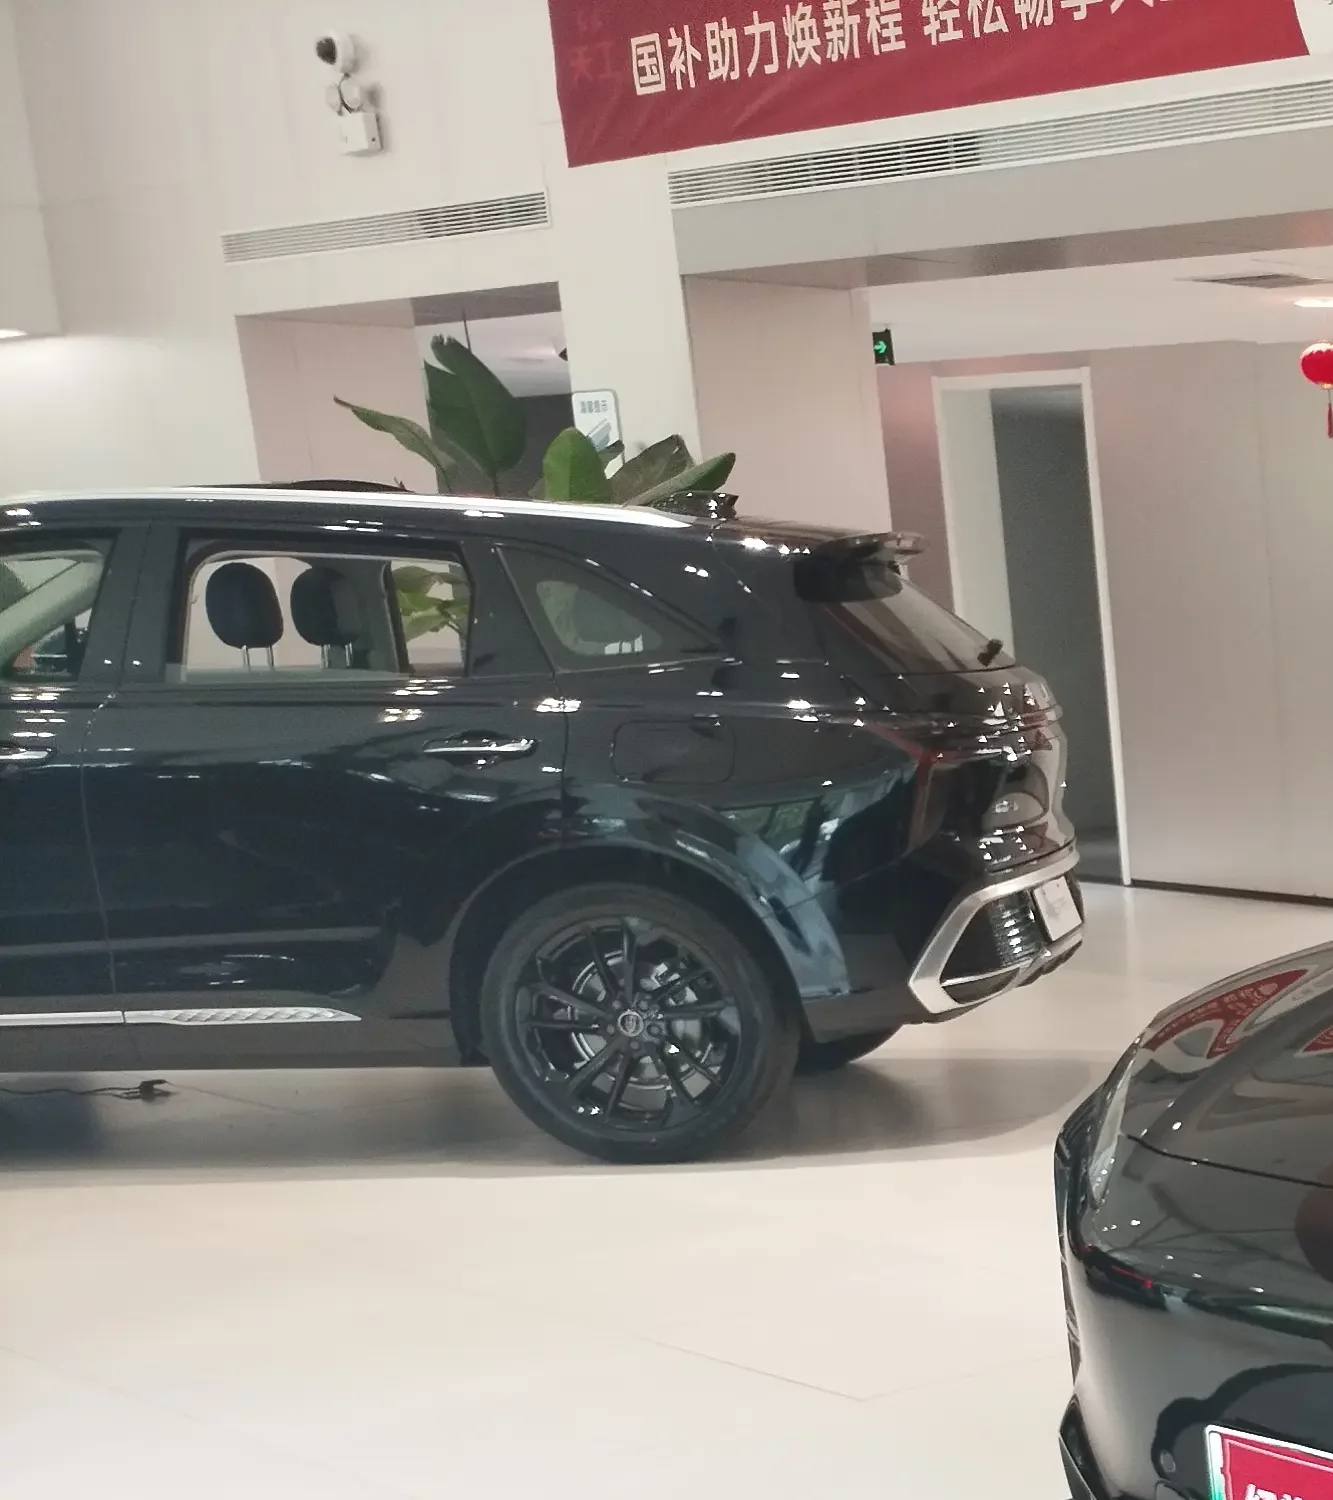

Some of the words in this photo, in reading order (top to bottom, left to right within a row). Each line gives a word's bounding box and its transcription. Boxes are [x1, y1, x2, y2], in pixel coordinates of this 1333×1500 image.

[630, 0, 906, 96] 国补助力焕新程
